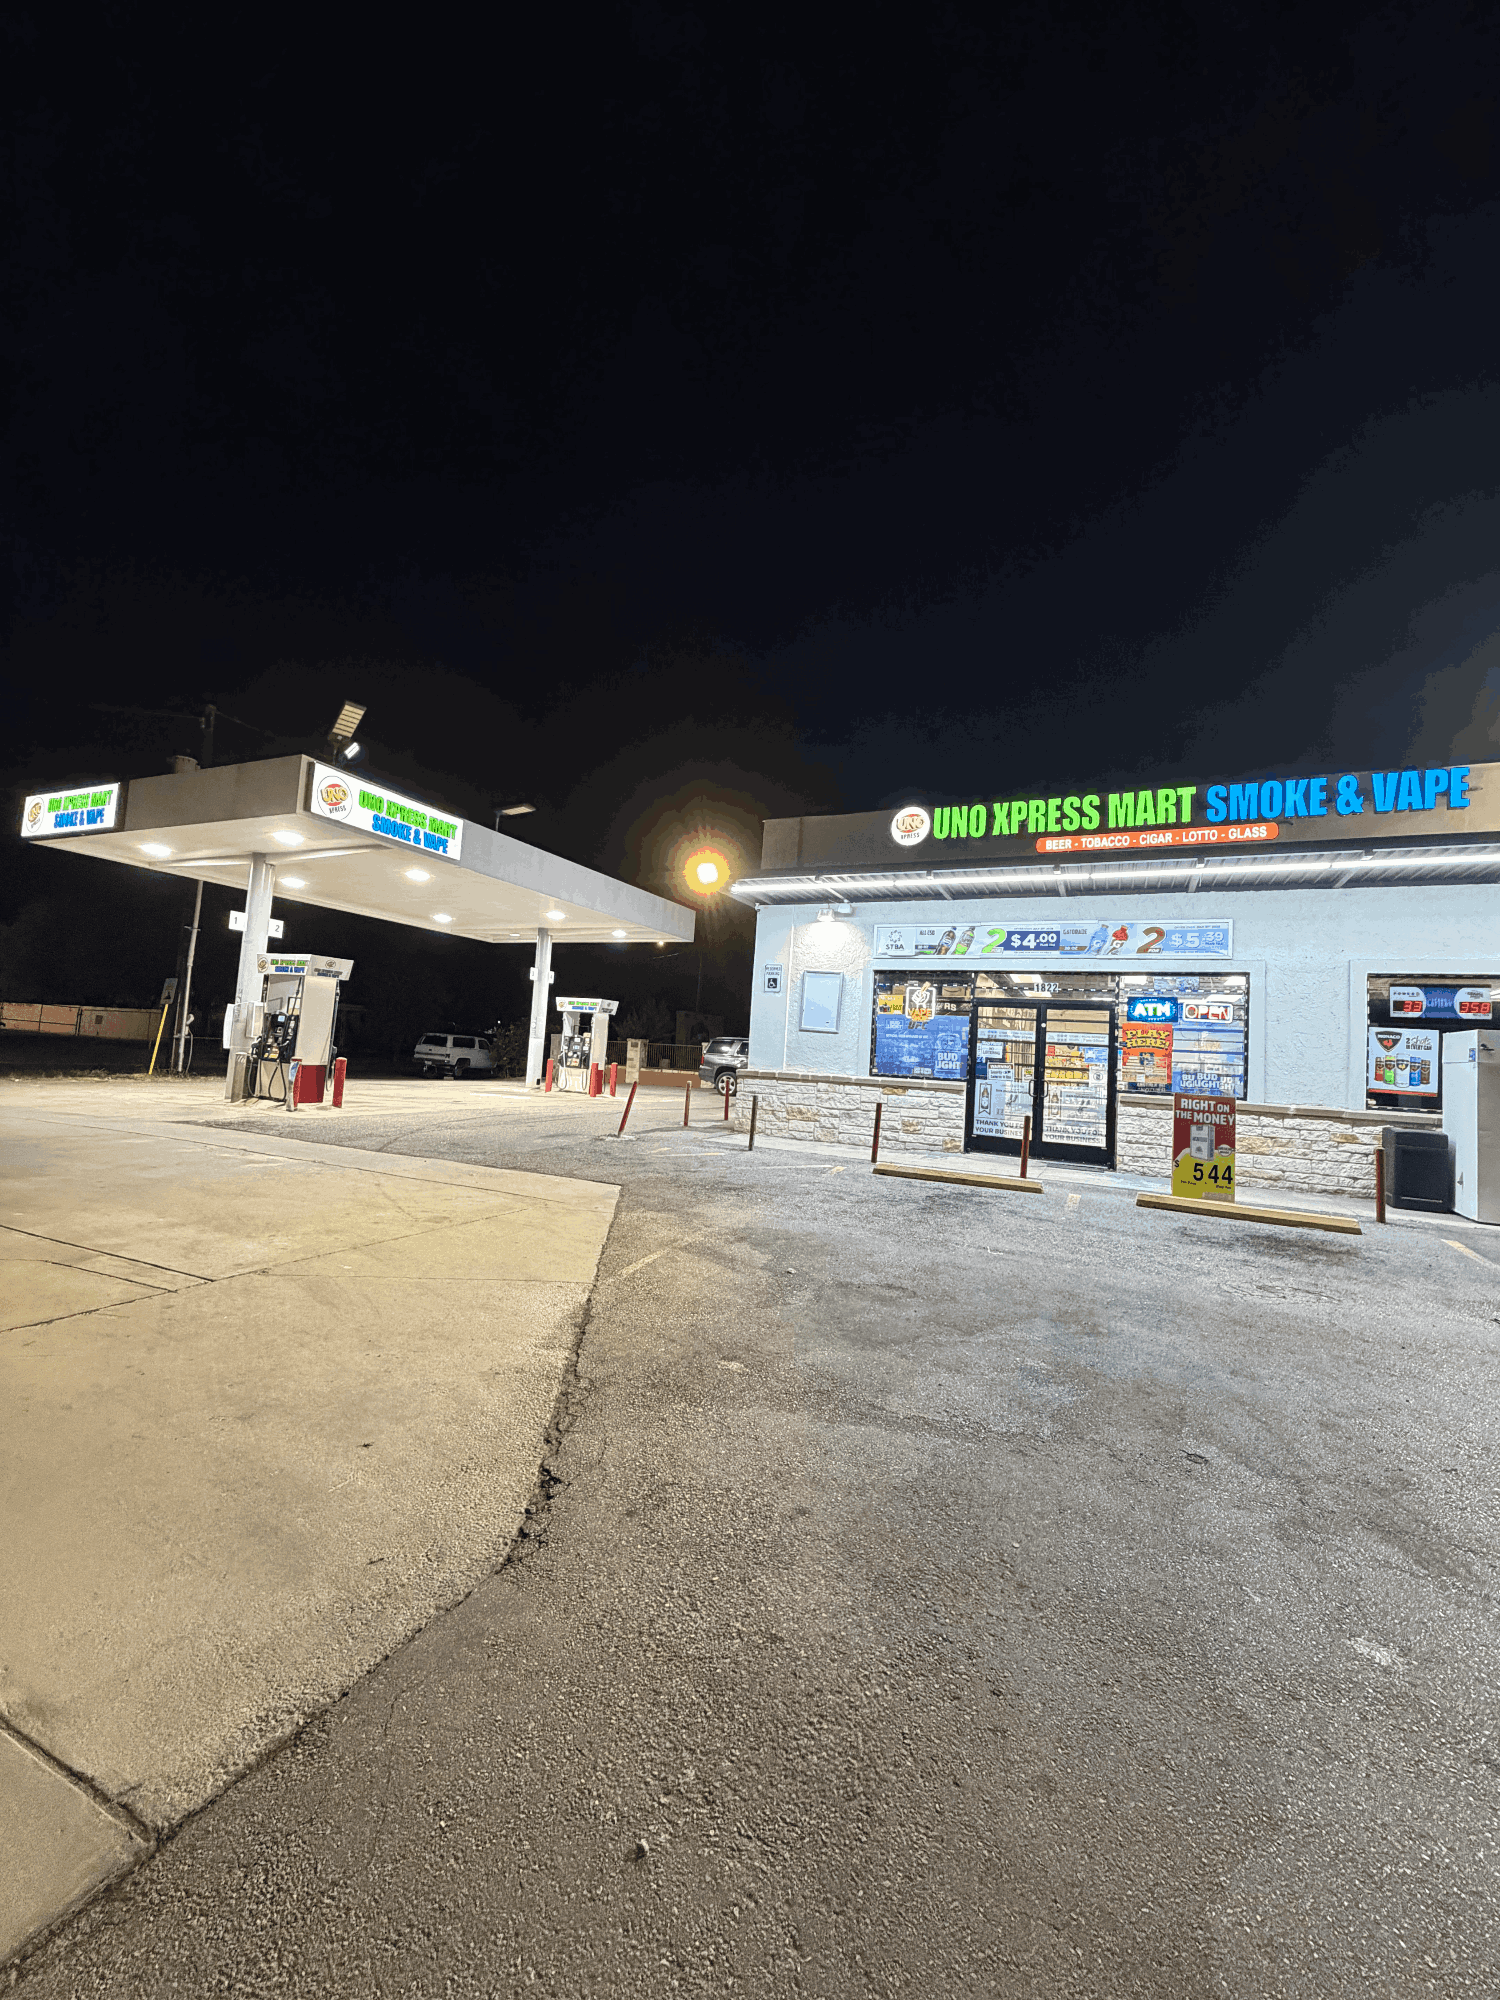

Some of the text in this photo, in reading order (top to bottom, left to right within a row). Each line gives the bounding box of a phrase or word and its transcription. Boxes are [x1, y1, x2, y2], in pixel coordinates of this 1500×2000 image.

[933, 767, 1470, 839] UNO XPRESS MART SMOKE & VAPE
[358, 789, 458, 840] UNO XPRESS MART
[372, 814, 449, 855] SMOKE & VAPE
[1045, 838, 1072, 850] BEER
[1080, 836, 1130, 848] TOBACCO
[1139, 833, 1172, 845] CIGAR
[1182, 829, 1218, 842] LOTTO
[1228, 826, 1268, 840] GLASS
[274, 925, 280, 933] 2
[981, 927, 1007, 954] 2
[1010, 933, 1058, 949] $4.00
[1136, 926, 1166, 954] 2
[1035, 983, 1058, 992] 1822
[1132, 1001, 1171, 1017] ATM
[1185, 1004, 1230, 1020] OPEN
[1403, 1000, 1423, 1012] 33
[1460, 1002, 1491, 1013] 358
[1125, 1029, 1170, 1039] PLAY
[1126, 1038, 1170, 1049] HERE!
[937, 1052, 958, 1061] BUD
[935, 1060, 962, 1070] LIGHT
[1196, 1072, 1218, 1081] BUD
[1194, 1079, 1221, 1089] LIGHT
[1180, 1098, 1230, 1113] RIGHT ON
[1175, 1110, 1235, 1126] THE MONEY
[994, 1129, 1023, 1137] BUSINES
[1045, 1125, 1070, 1134] THANK
